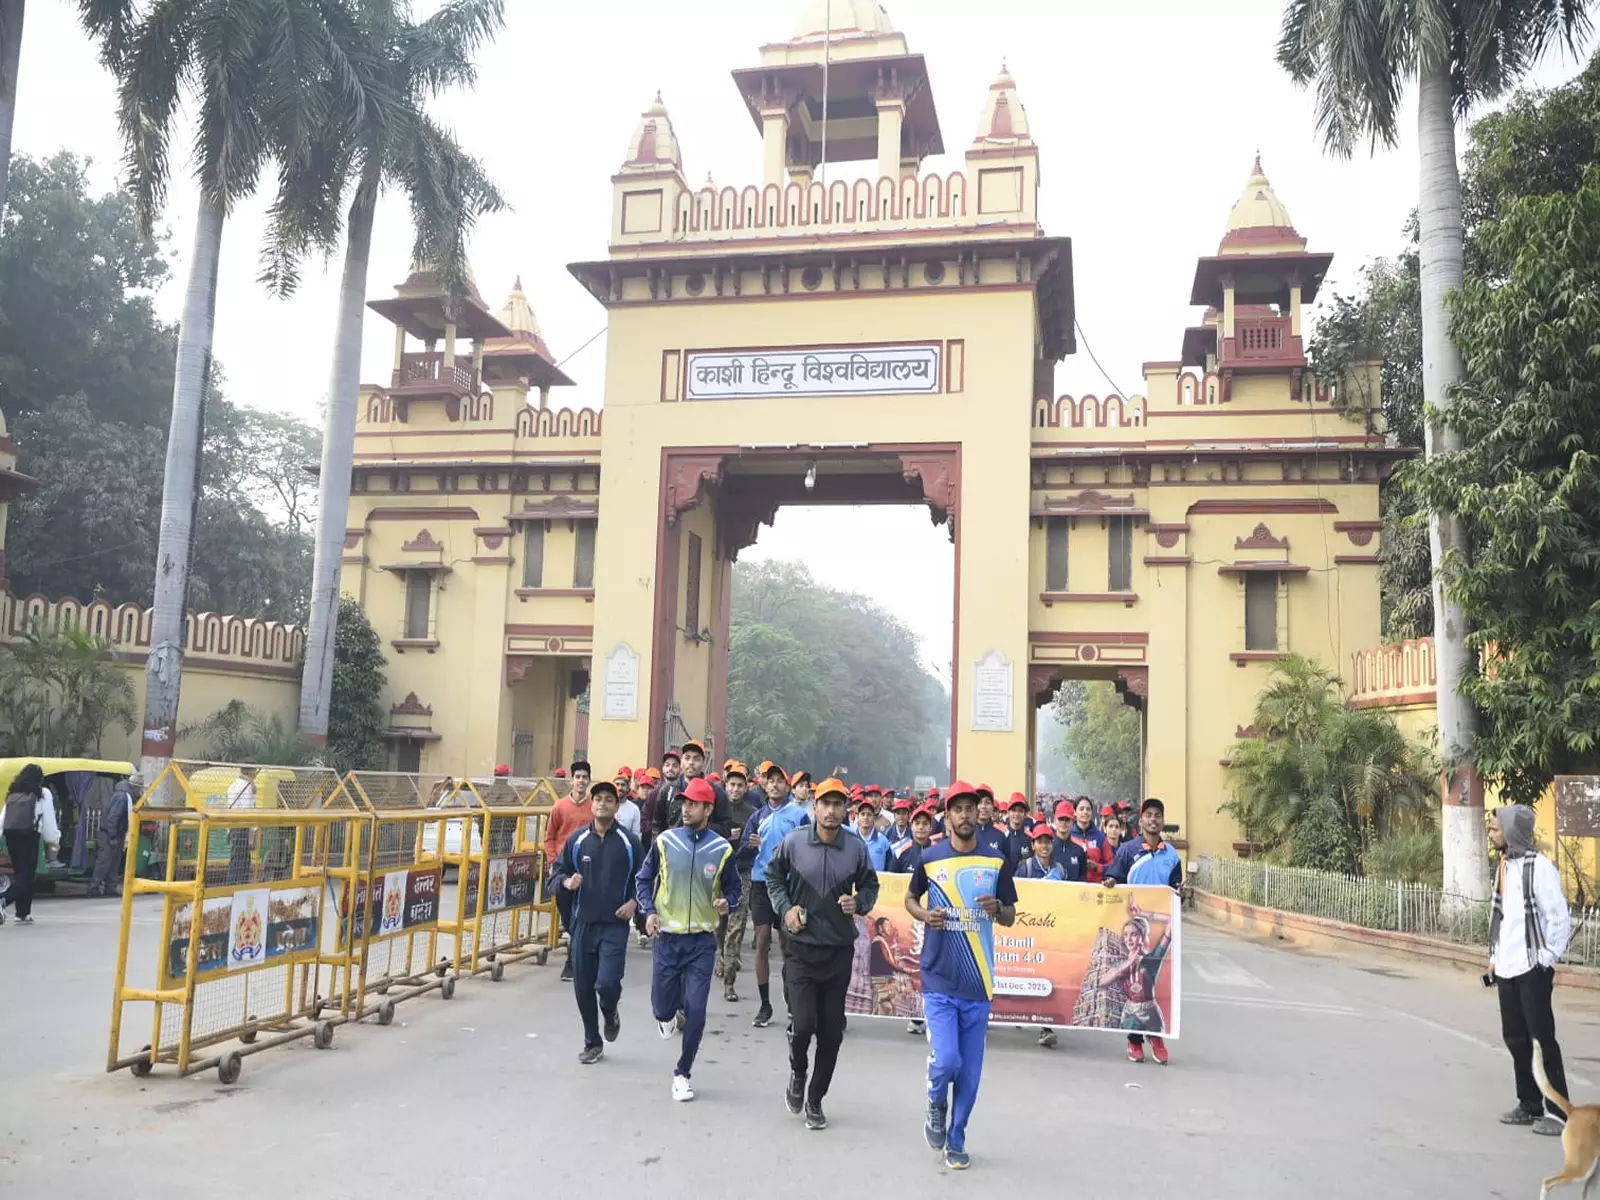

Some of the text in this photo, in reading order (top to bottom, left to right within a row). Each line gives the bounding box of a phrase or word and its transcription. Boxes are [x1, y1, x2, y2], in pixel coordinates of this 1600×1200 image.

[696, 354, 931, 390] काशी हिन्दू विश्वविद्यालय
[1015, 911, 1056, 928] Kashi
[1022, 950, 1045, 965] 4.0
